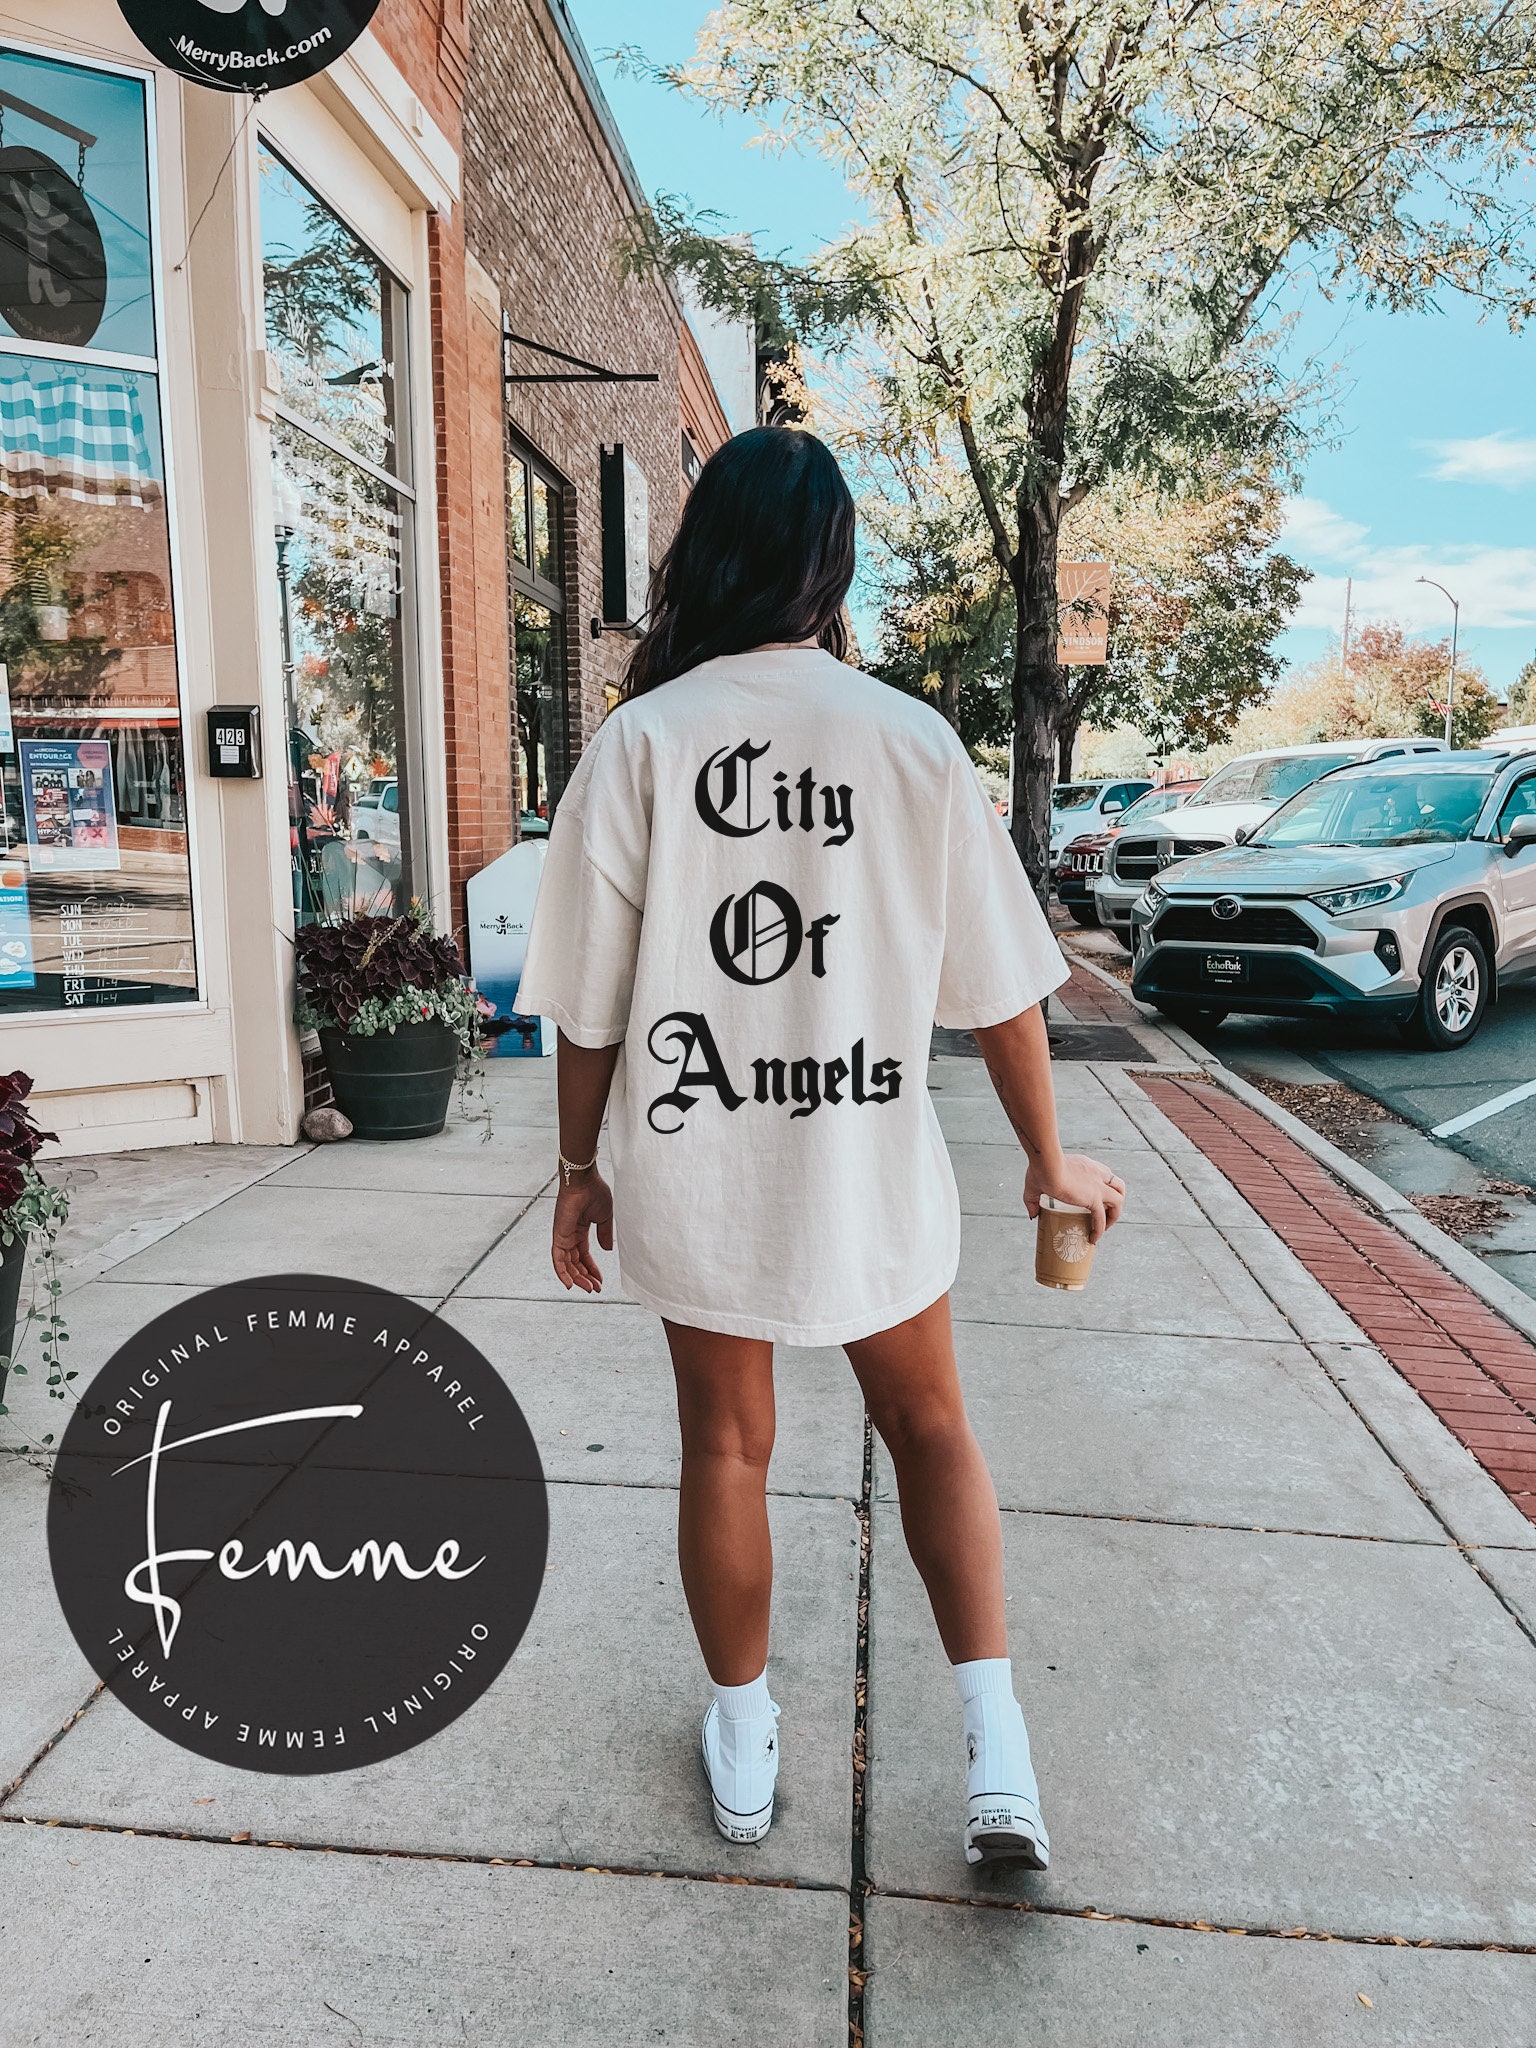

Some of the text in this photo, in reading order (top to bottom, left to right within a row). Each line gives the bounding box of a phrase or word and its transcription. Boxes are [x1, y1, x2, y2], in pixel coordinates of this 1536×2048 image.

[176, 26, 332, 71] MerryBack.com
[217, 729, 245, 745] 423
[694, 738, 854, 847] City
[60, 902, 135, 916] SUN CLOSED
[60, 918, 134, 931] MON CLOSED
[480, 922, 500, 930] Merry
[709, 880, 841, 986] Of
[62, 935, 83, 946] TUE
[62, 950, 84, 961] WED
[63, 964, 85, 976] THU
[1206, 960, 1242, 970] EchoPark
[63, 977, 119, 991] FRI 11-4
[65, 993, 118, 1006] SAT 11-4
[647, 1011, 902, 1134] Angels
[981, 1814, 1012, 1826] ALL STAR
